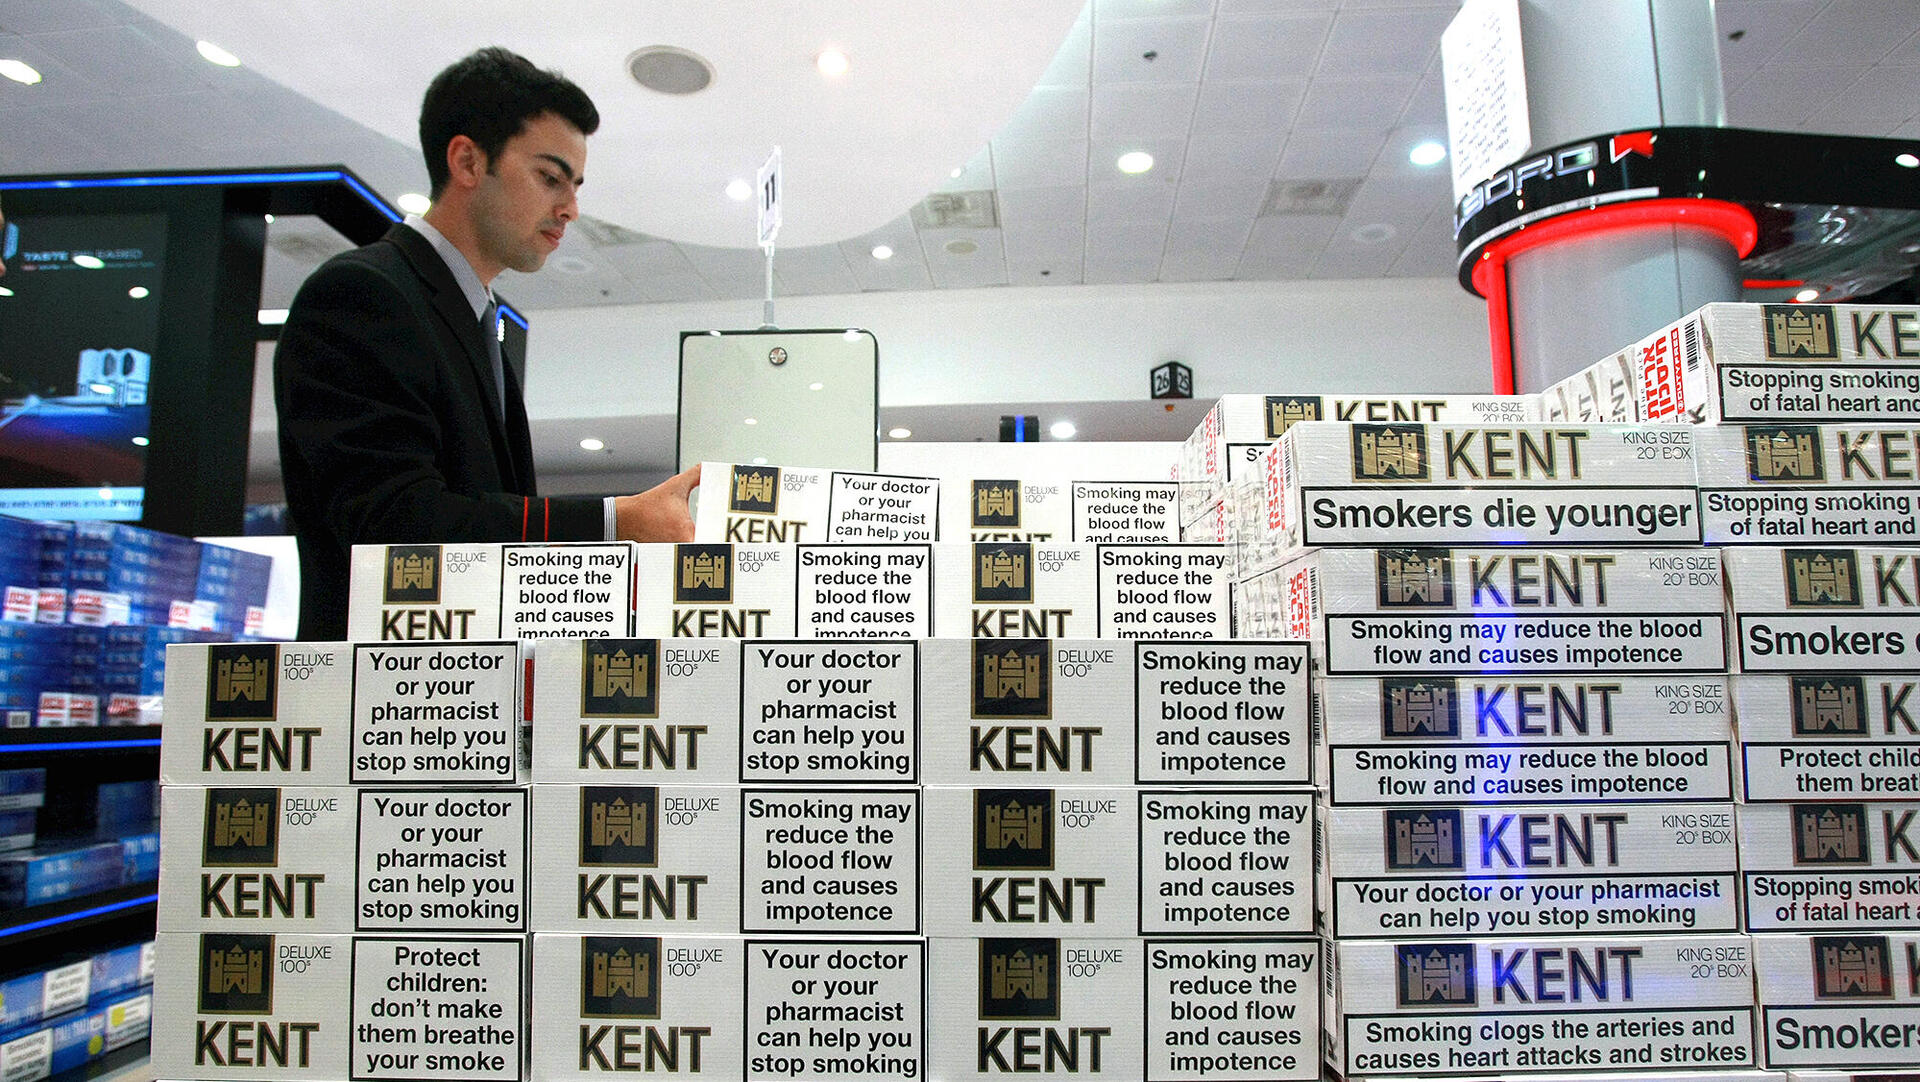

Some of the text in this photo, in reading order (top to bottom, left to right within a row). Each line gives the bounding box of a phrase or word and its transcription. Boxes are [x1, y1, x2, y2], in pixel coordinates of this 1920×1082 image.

[23, 251, 68, 261] TASTE
[1157, 372, 1170, 391] 26
[1643, 343, 1660, 419] אריזת
[1656, 336, 1675, 416] חיסכון
[1729, 369, 1920, 393] Stopping smoking
[1472, 402, 1525, 412] KING SIZE
[1750, 393, 1770, 411] of
[1775, 393, 1820, 411] fatal
[1827, 394, 1881, 412] heart
[1623, 432, 1690, 445] KING SIZE
[1443, 429, 1590, 481] KENT
[1663, 447, 1692, 460] BOX
[784, 474, 818, 484] DELUXE
[842, 477, 930, 494] Your doctor
[859, 497, 911, 509] or your
[1708, 492, 1911, 516] Stopping smoking
[842, 509, 925, 525] pharmacist
[1313, 498, 1692, 536] Smokers die younger
[1730, 516, 1916, 535] of fatal heart and
[725, 517, 808, 543] KENT
[836, 525, 929, 542] can help you
[446, 552, 486, 563] DELUXE
[507, 552, 625, 569] Smoking may
[1650, 557, 1716, 570] KING SIZE
[519, 570, 612, 585] reduce the
[1468, 555, 1616, 607] KENT
[1689, 573, 1718, 586] BOX
[520, 589, 610, 604] blood flow
[381, 609, 476, 640] KENT
[515, 608, 614, 623] and causes
[672, 609, 771, 638] KENT
[971, 609, 1072, 638] KENT
[1352, 619, 1702, 643] Smoking may reduce the blood
[1750, 625, 1905, 655] Smokers
[665, 649, 720, 663] DELUXE
[758, 649, 901, 668] Your doctor
[1373, 644, 1682, 668] flow and causes impotence
[787, 679, 872, 698] or your
[762, 700, 897, 723] pharmacist
[1475, 683, 1621, 737] KENT
[578, 724, 708, 770] KENT
[753, 725, 904, 749] can help you
[202, 728, 322, 772] KENT
[970, 726, 1101, 772] KENT
[1780, 748, 1862, 767] Protect
[747, 751, 909, 775] stop smoking
[1796, 773, 1853, 792] them
[1061, 800, 1116, 814] DELUXE
[1146, 800, 1308, 824] Smoking may
[1662, 815, 1730, 828] KING SIZE
[1164, 826, 1290, 845] reduce the
[1479, 812, 1628, 869] KENT
[1702, 831, 1732, 844] BOX
[1165, 852, 1289, 871] blood flow
[201, 874, 325, 918] KENT
[577, 874, 708, 920] KENT
[1159, 877, 1294, 896] and causes
[1353, 878, 1720, 905] Your doctor or your pharmacist
[972, 877, 1105, 923] KENT
[1165, 903, 1290, 926] impotence
[1380, 904, 1696, 931] can help you stop smoking
[280, 945, 331, 960] DELUXE
[395, 946, 480, 967] Protect
[1677, 947, 1745, 961] KING SIZE
[387, 972, 486, 992] children:
[1491, 947, 1642, 1004] KENT
[1717, 964, 1748, 978] BOX
[371, 998, 502, 1018] don't make
[357, 1023, 514, 1045] them breathe
[1366, 1015, 1734, 1046] Smoking clogs the arteries and
[195, 1020, 320, 1067] KENT
[579, 1025, 711, 1072] KENT
[978, 1027, 1111, 1073] KENT
[367, 1051, 504, 1073] your smoke
[1355, 1042, 1747, 1069] causes heart attacks and strokes
